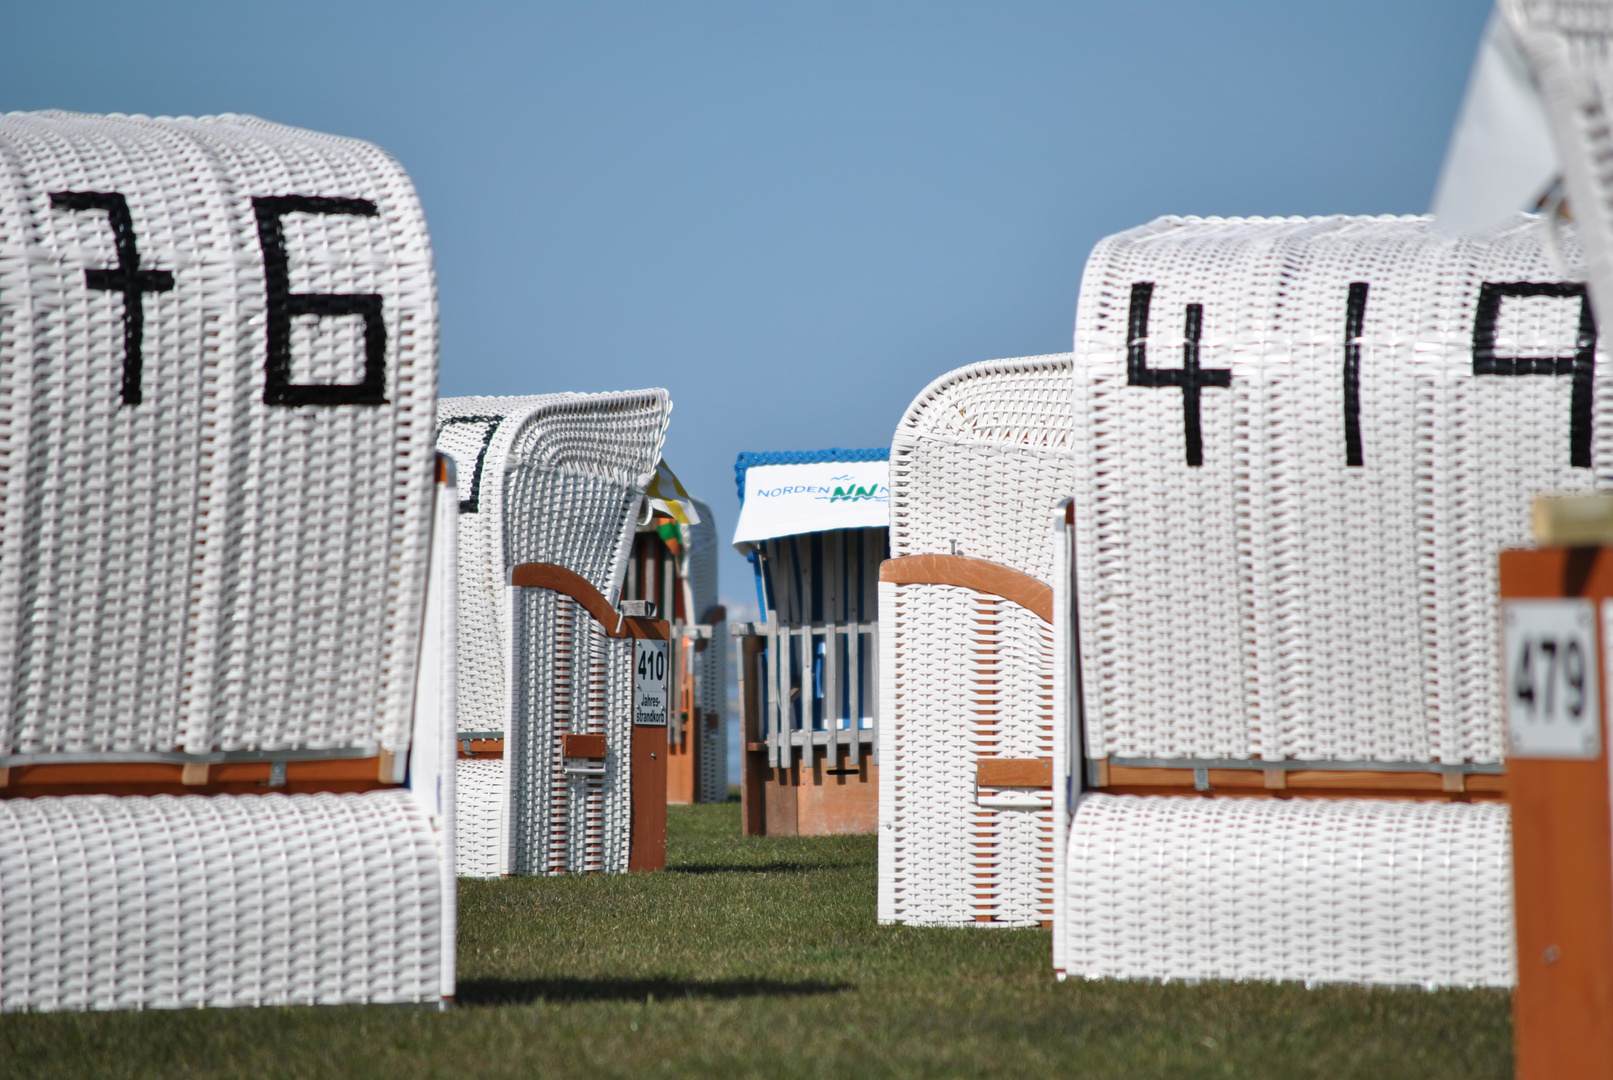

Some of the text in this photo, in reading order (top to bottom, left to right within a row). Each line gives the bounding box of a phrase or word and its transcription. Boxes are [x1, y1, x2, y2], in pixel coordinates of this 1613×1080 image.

[48, 191, 391, 406] 76
[1127, 281, 1597, 467] 419
[757, 485, 831, 498] NORDEN
[638, 651, 664, 681] 410
[1515, 636, 1586, 721] 479
[641, 694, 661, 707] Jahres-
[636, 709, 664, 723] strandkorb
